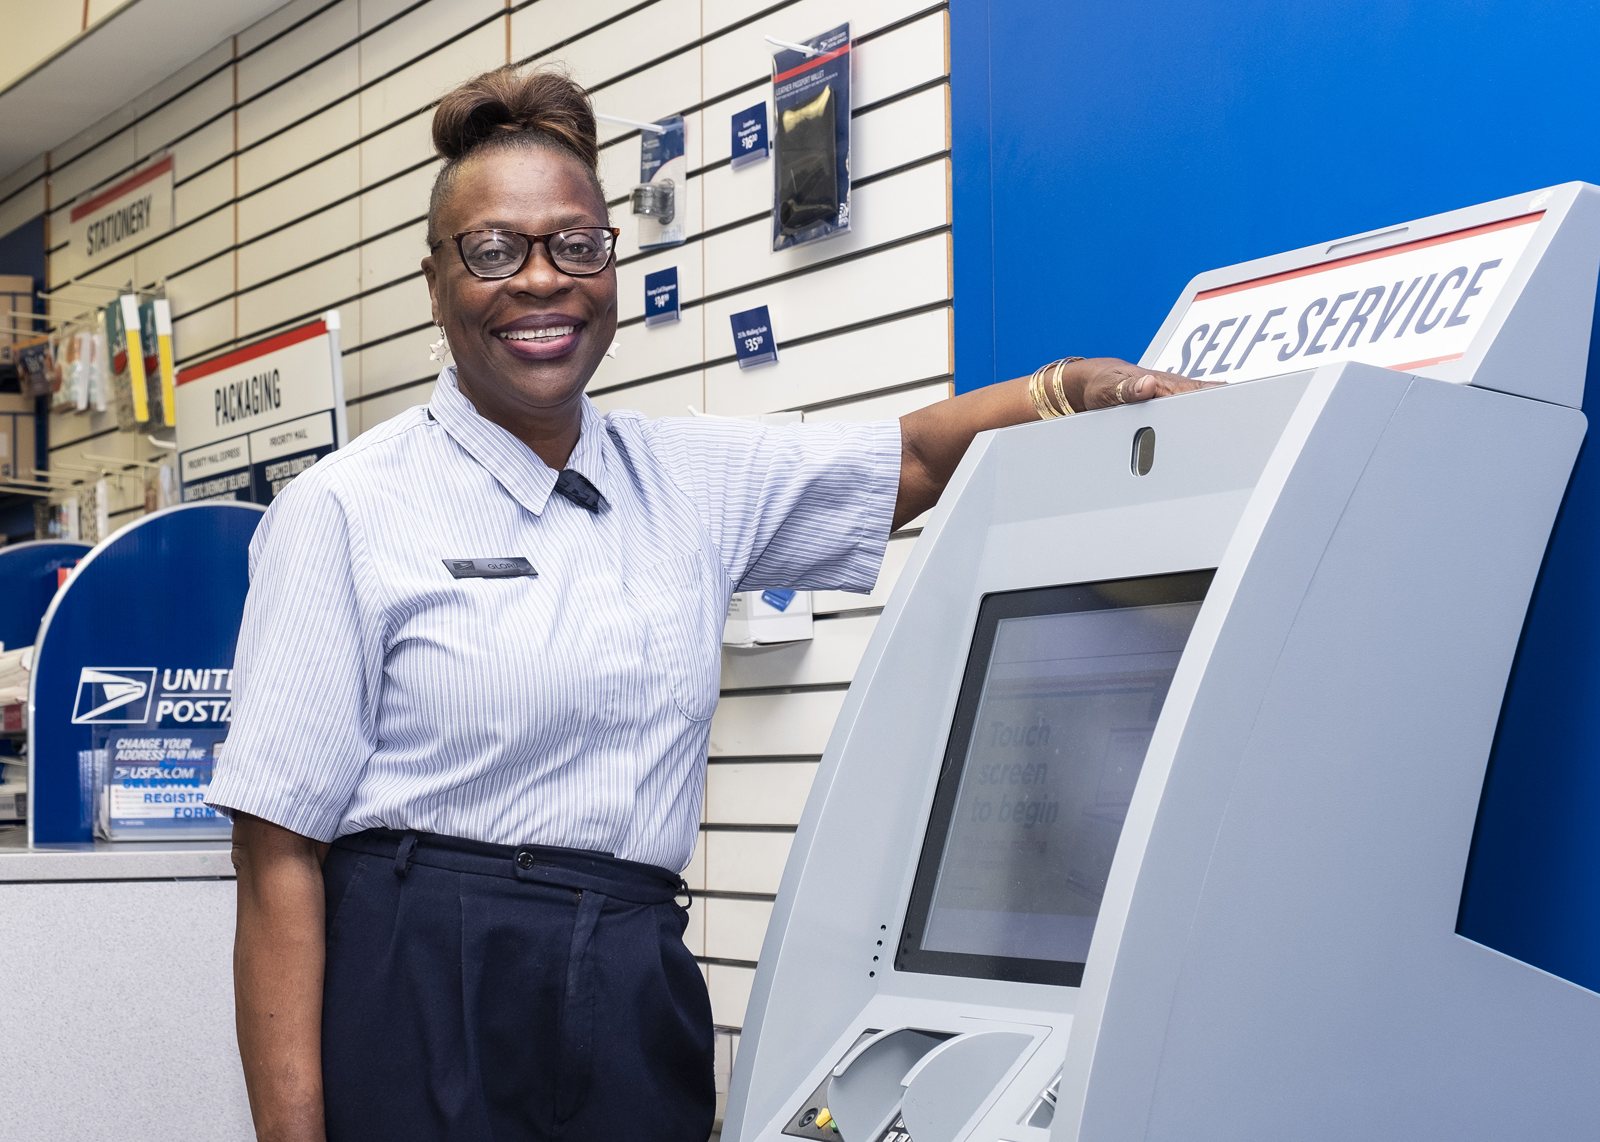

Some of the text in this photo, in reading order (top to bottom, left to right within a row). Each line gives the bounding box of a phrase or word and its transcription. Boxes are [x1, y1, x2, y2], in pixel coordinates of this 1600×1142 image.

[87, 193, 152, 257] STATIONERY
[1167, 257, 1503, 378] SELF-SERVICE
[215, 368, 281, 428] PACKAGING
[269, 428, 308, 447] PRIORITY MAIL
[116, 738, 192, 750] CHANGE YOUR
[990, 720, 1050, 747] Touch
[115, 749, 165, 760] ADDRESS
[978, 761, 1047, 785] screen
[174, 807, 216, 818] FORM
[971, 795, 1059, 829] to begin
